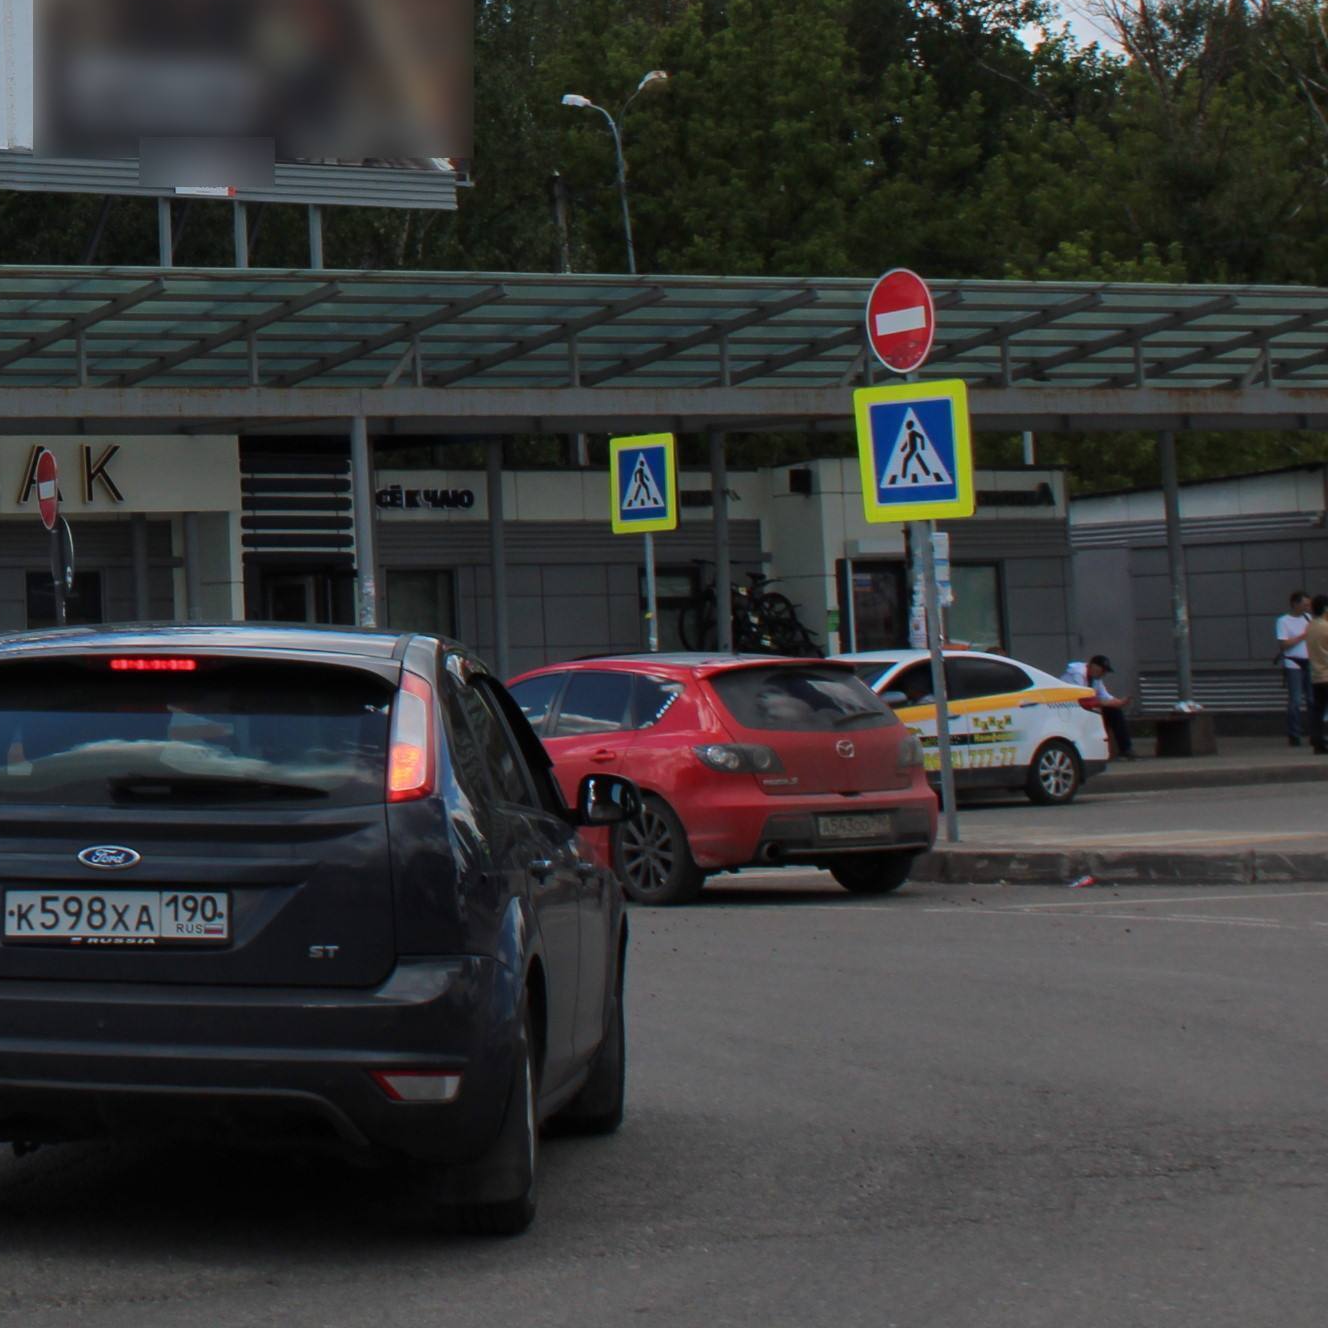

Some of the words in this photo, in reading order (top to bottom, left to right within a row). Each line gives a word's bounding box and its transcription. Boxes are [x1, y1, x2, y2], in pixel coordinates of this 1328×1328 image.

[91, 848, 125, 864] Ford
[16, 894, 155, 932] К598ХА
[164, 894, 218, 922] 190
[176, 923, 203, 934] RUS
[308, 945, 340, 958] ST
